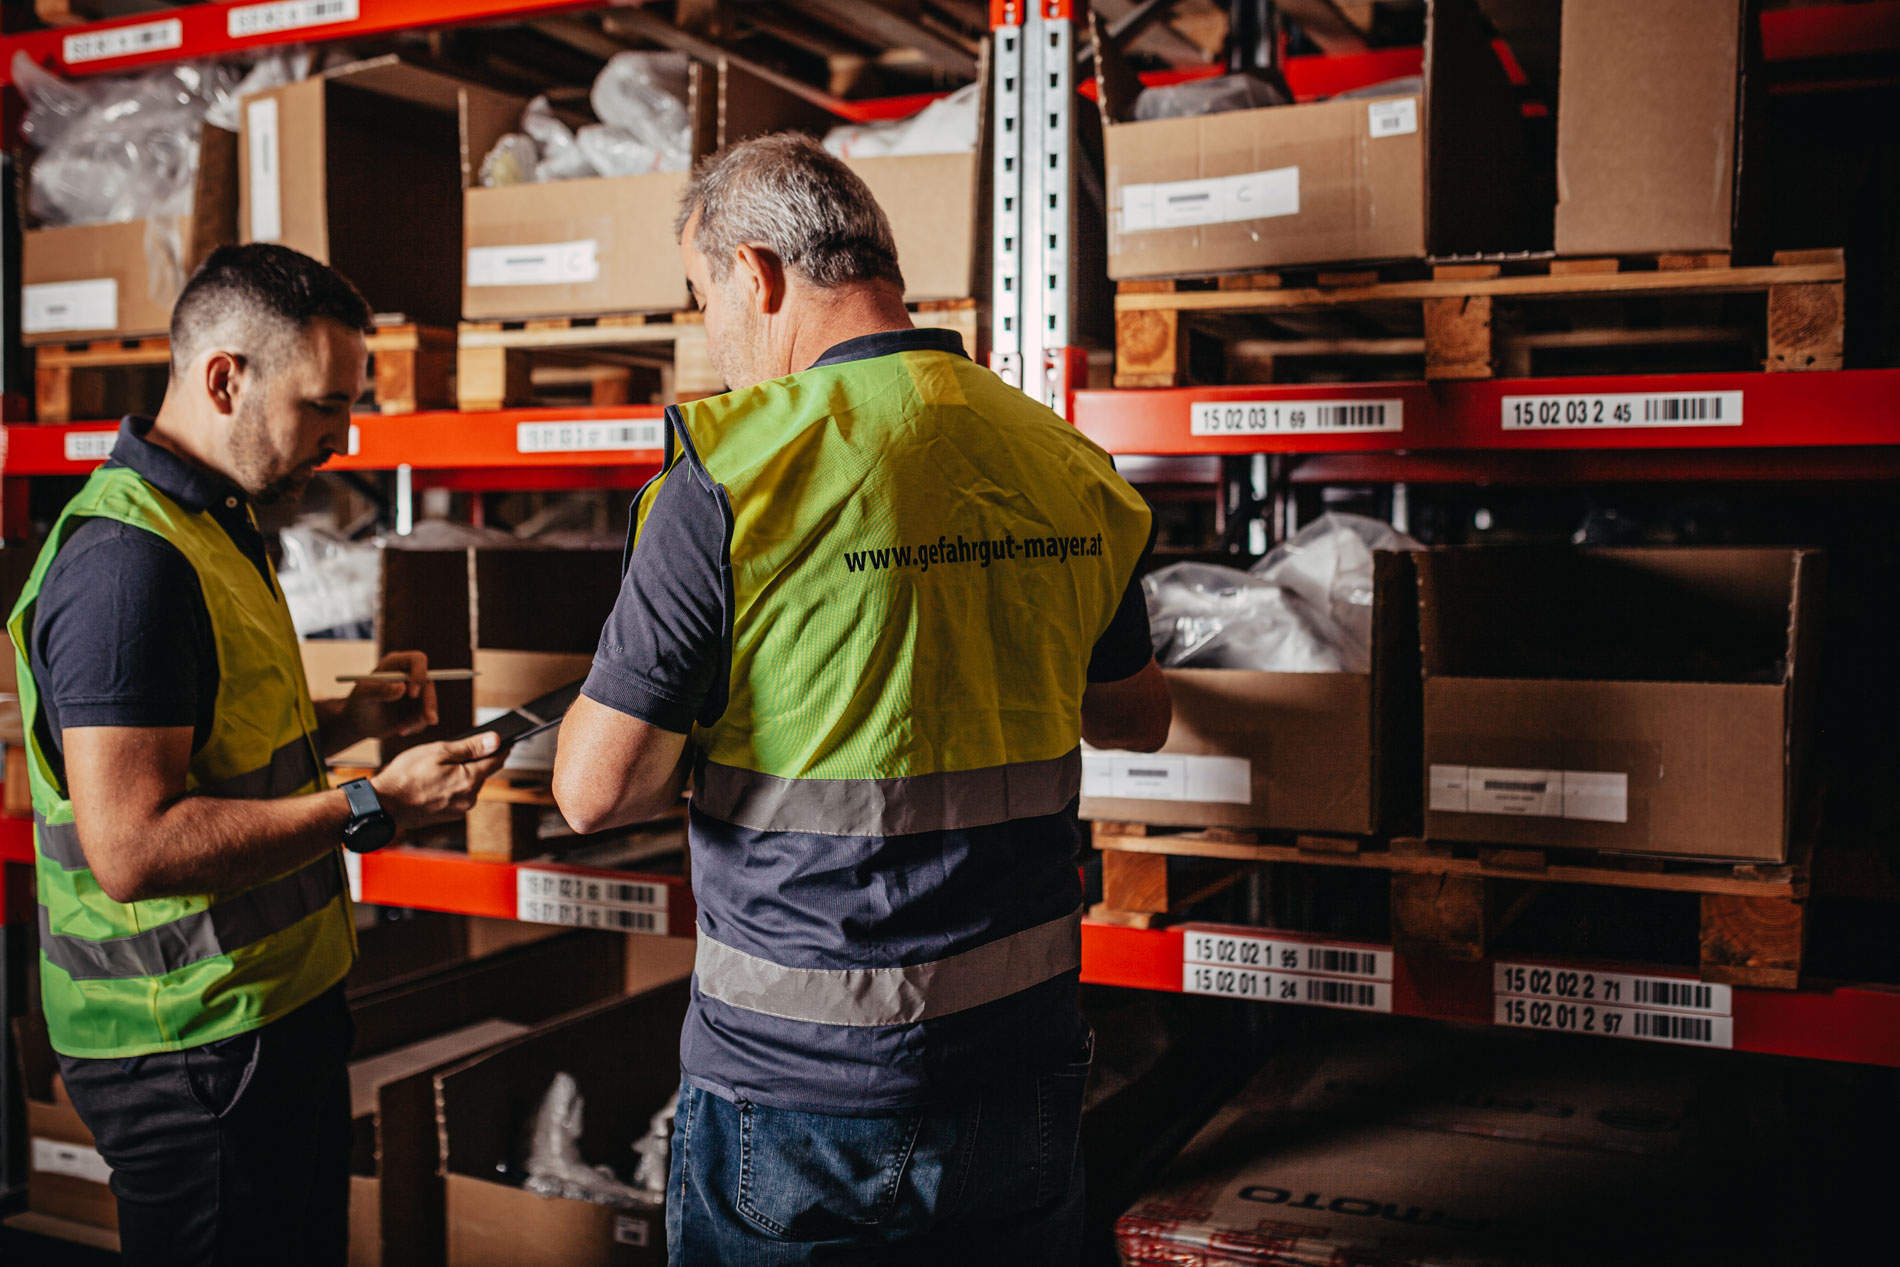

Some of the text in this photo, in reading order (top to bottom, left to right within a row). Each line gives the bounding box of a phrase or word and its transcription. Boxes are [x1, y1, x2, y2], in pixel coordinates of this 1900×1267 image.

[1203, 407, 1305, 430] 15 02 03 1 69
[1515, 398, 1632, 425] 15 02 03 2 45
[844, 532, 1103, 572] www.gefahrgut-mayer.at
[1195, 937, 1298, 968] 15 02 02 1 95
[1195, 968, 1297, 999] 15 02 01 1 24
[1505, 967, 1620, 1002] 15 02 02 2 71
[1505, 1000, 1622, 1033] 15 02 01 2 97
